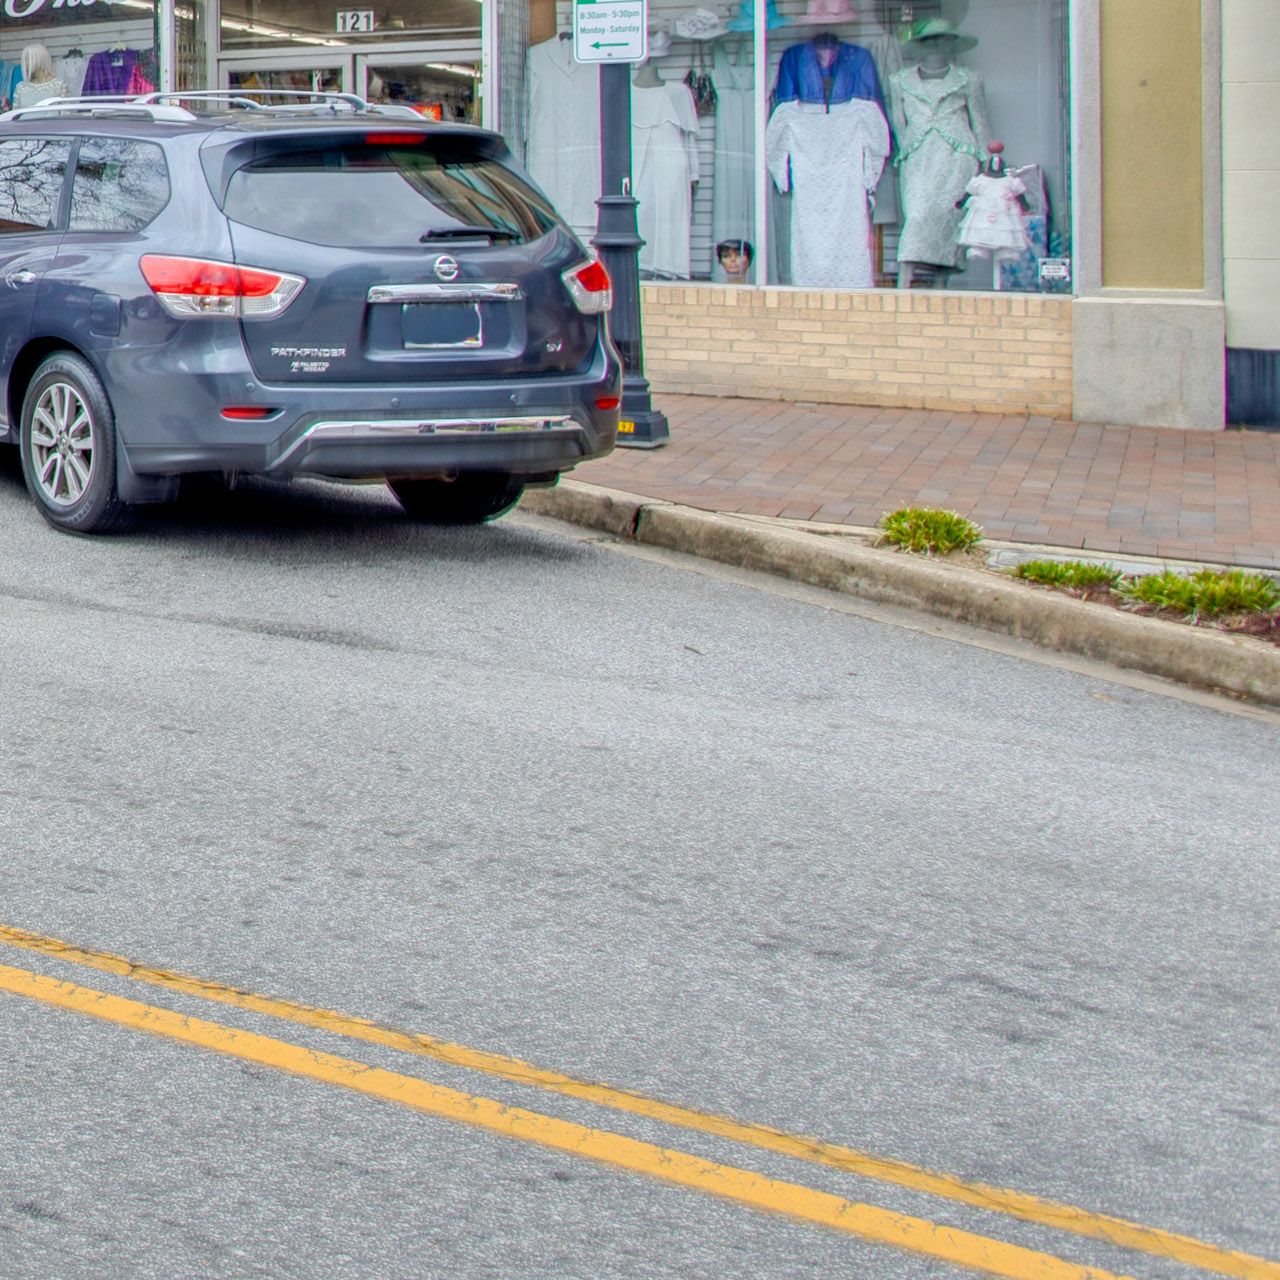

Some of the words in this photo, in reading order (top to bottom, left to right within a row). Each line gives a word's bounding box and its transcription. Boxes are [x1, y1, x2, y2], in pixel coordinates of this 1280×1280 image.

[612, 10, 640, 19] 5:30pm
[339, 13, 371, 31] 121
[579, 27, 606, 35] Monday
[610, 25, 640, 34] Saturday
[270, 348, 347, 358] PATHFINDER
